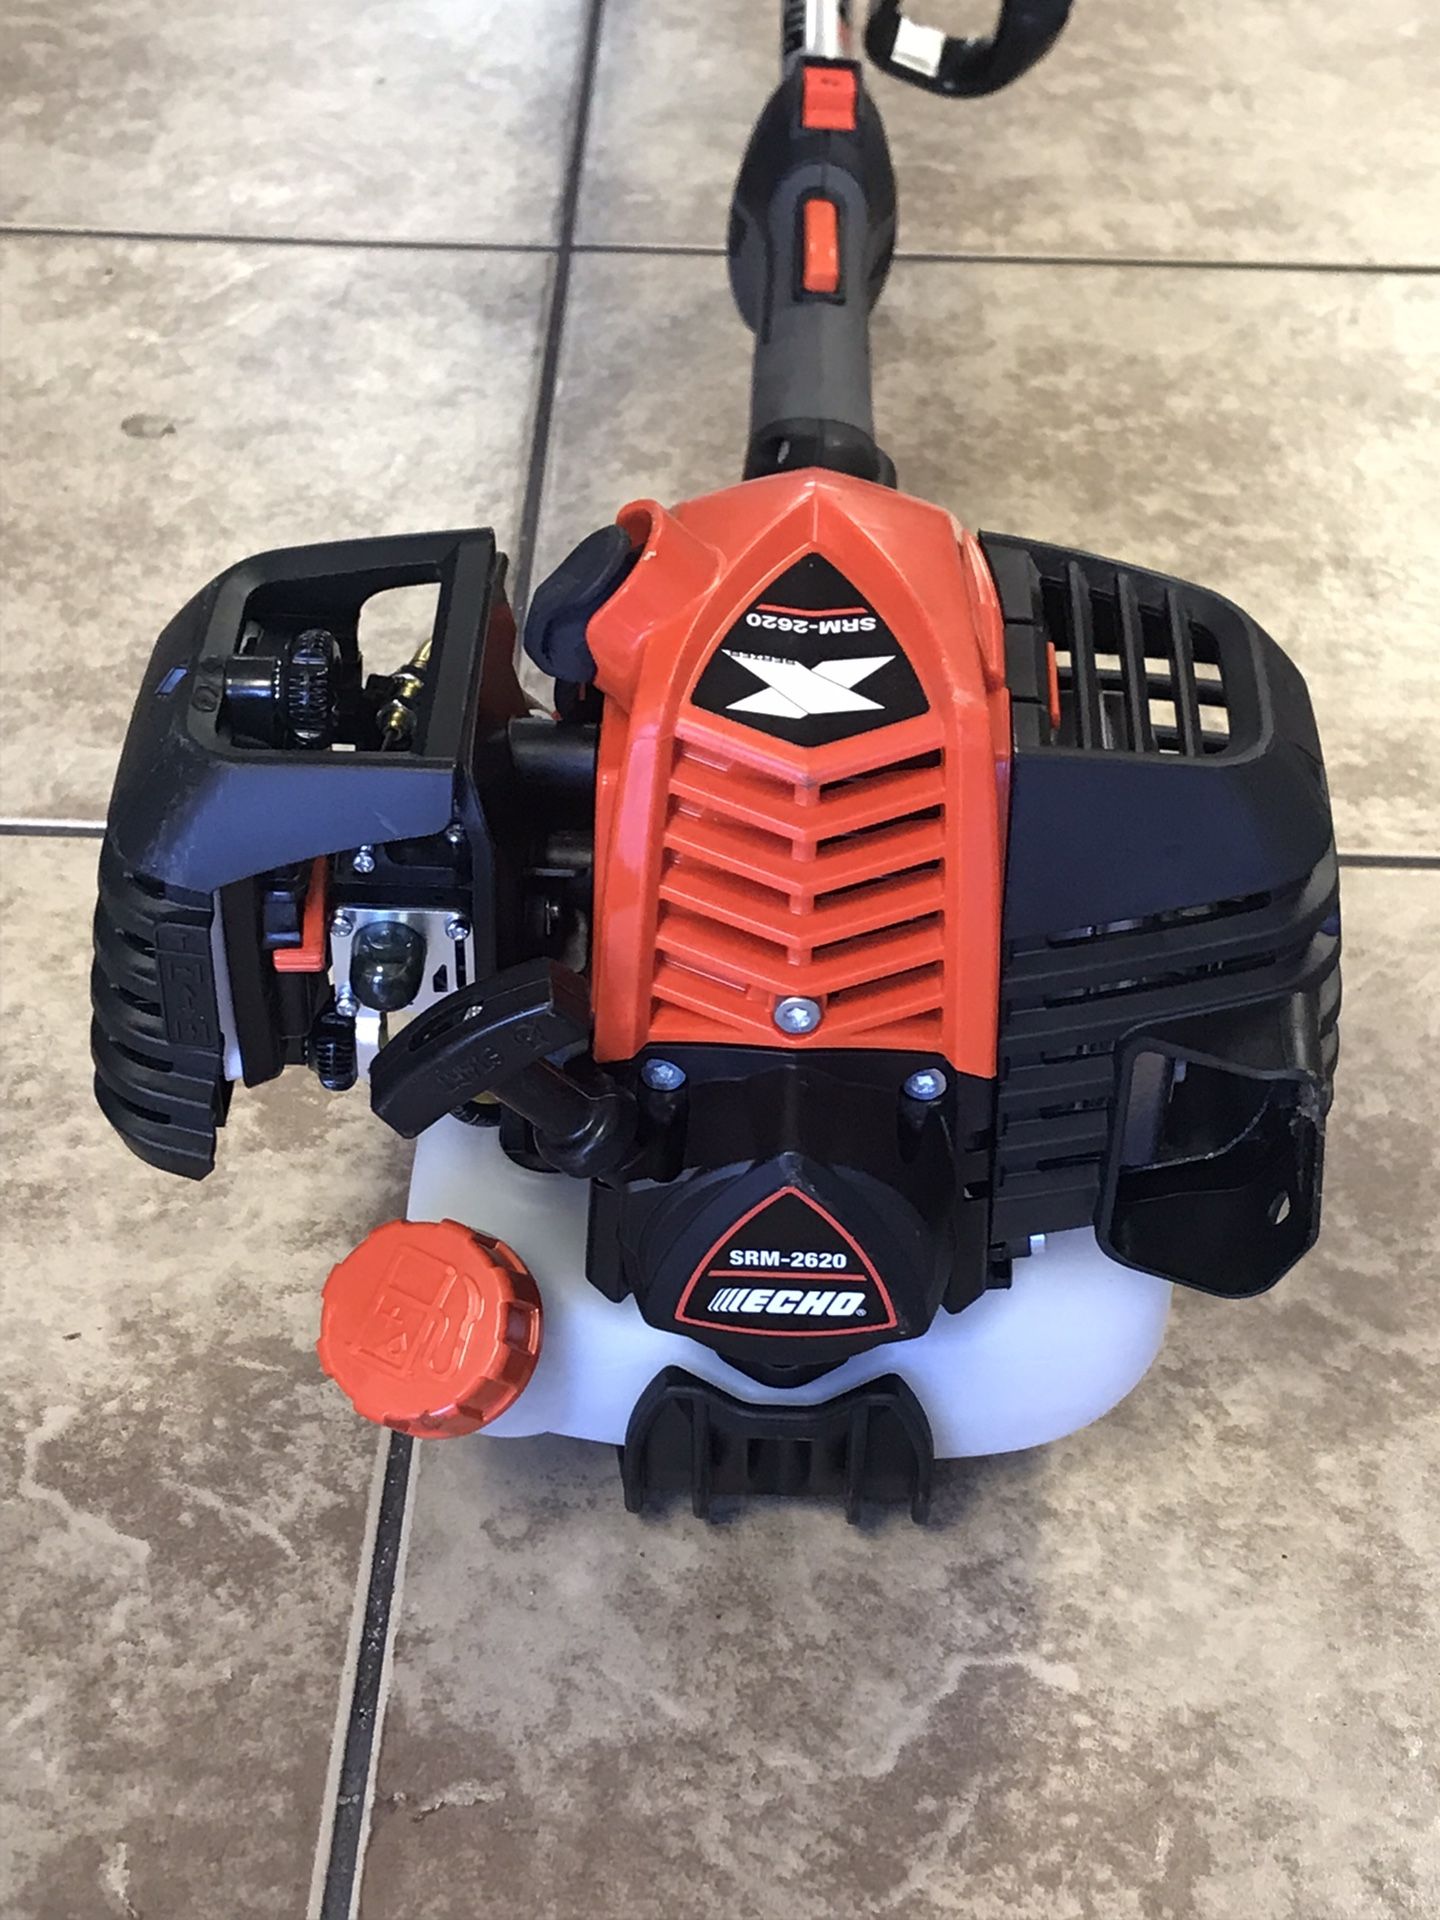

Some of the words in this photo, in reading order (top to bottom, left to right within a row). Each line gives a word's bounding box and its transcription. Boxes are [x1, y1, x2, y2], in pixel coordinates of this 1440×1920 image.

[746, 613, 876, 634] SRM-2620
[729, 1250, 847, 1269] SRM-2620
[738, 1288, 866, 1317] ECHO
